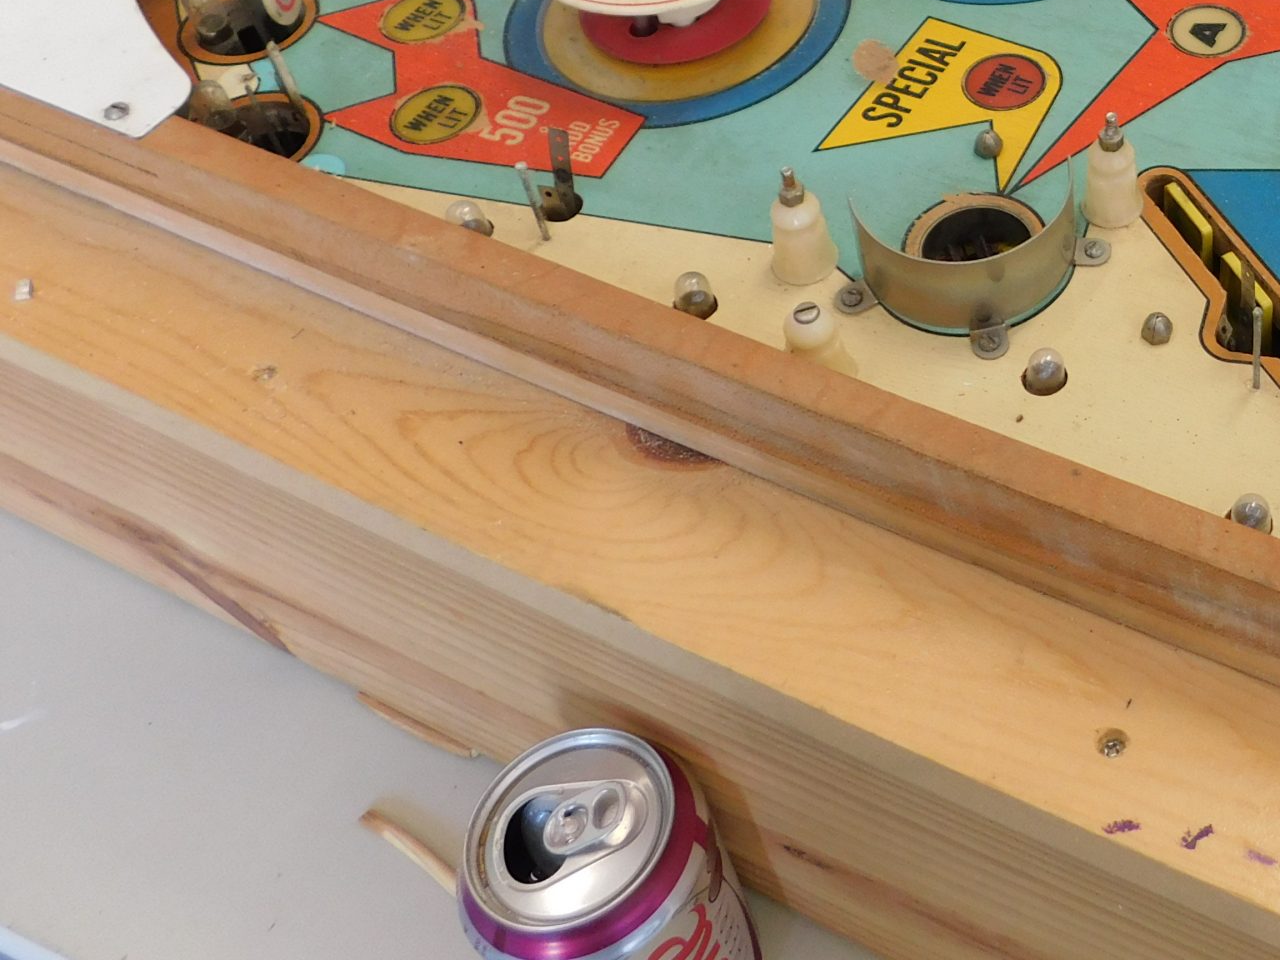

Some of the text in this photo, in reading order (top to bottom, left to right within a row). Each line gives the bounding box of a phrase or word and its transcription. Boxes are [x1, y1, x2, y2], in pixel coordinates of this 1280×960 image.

[421, 11, 453, 31] LIT
[1188, 22, 1228, 49] A
[861, 38, 967, 129] SPECIAL
[976, 63, 1018, 98] WHEN
[1007, 74, 1034, 96] LIT
[403, 94, 456, 133] WHEN
[437, 107, 468, 130] LIT
[478, 95, 551, 146] 500
[567, 120, 592, 152] DD
[570, 118, 621, 163] BONUS
